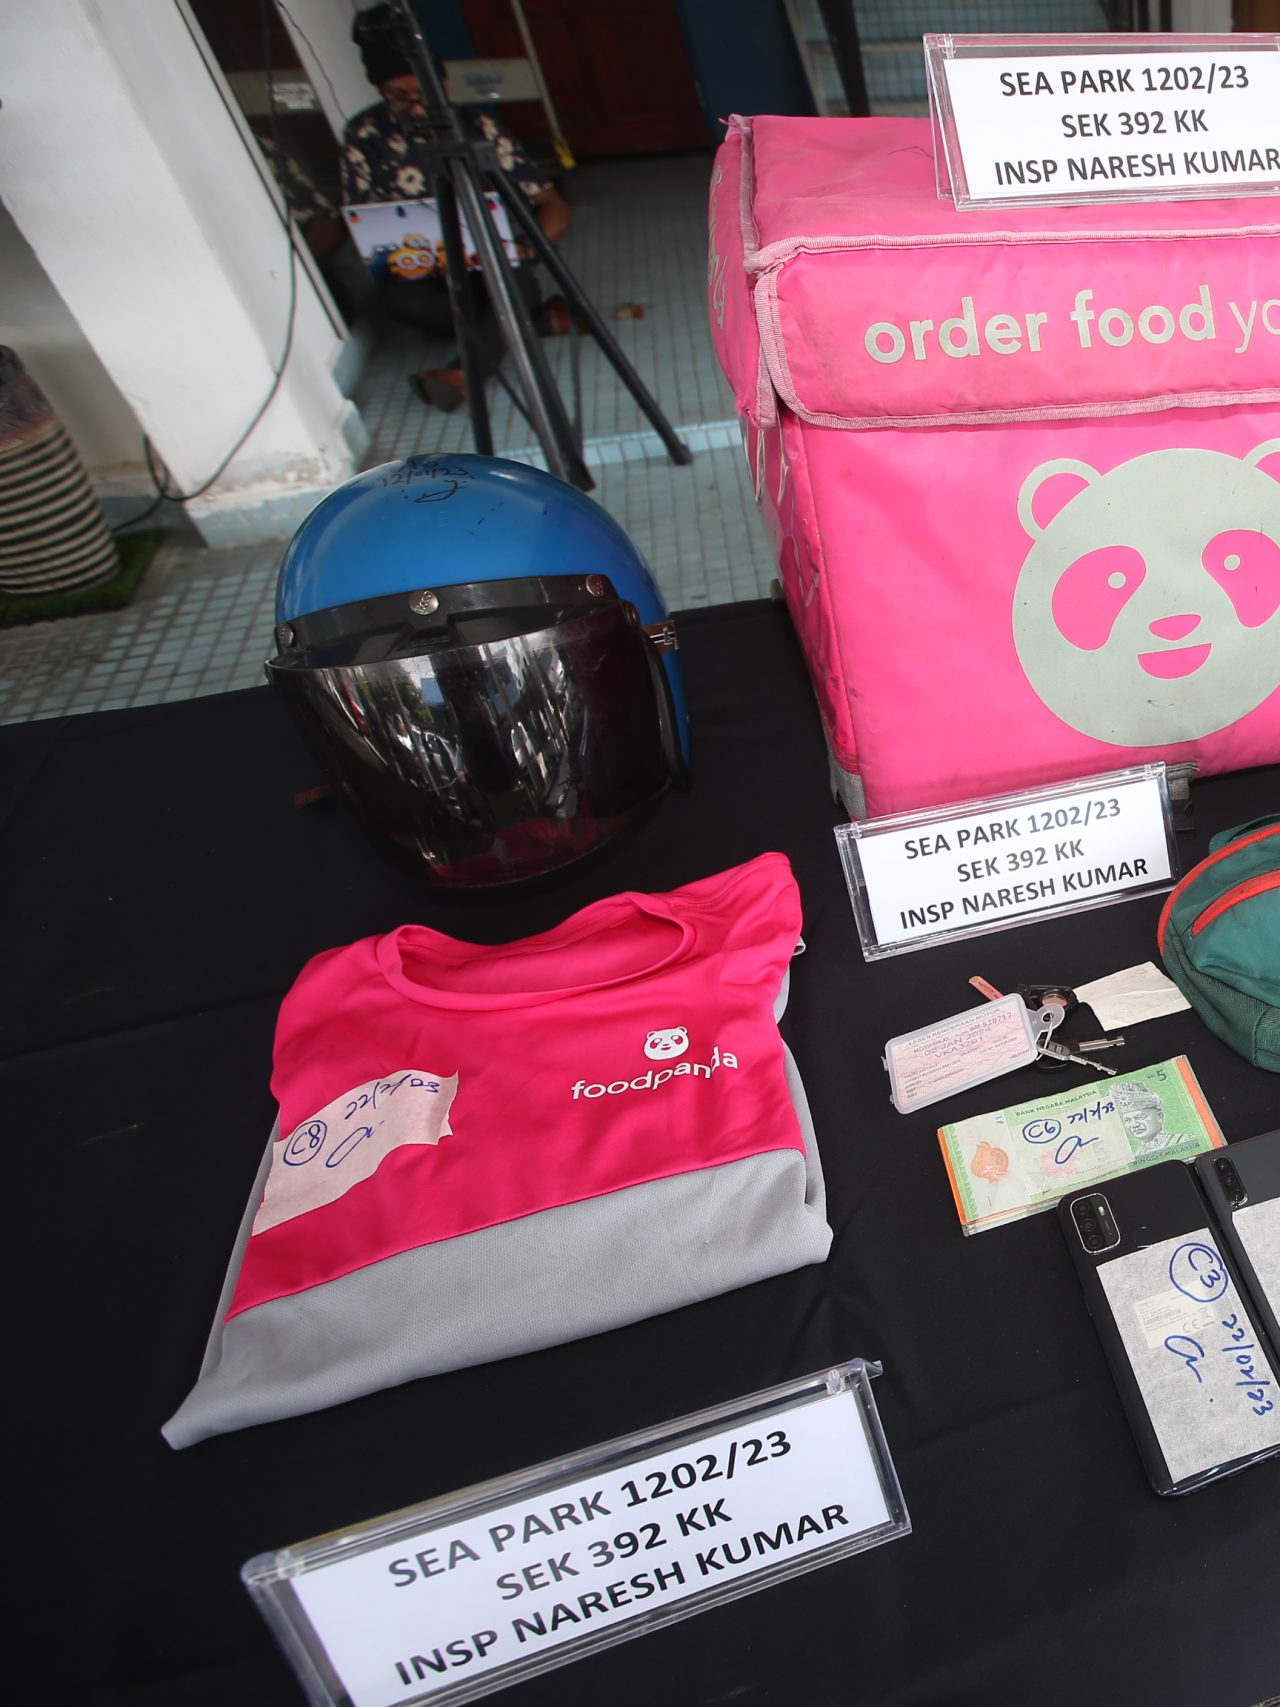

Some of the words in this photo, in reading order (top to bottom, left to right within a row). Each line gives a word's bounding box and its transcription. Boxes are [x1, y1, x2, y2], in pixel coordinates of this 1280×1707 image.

[999, 71, 1054, 97] SEA
[1062, 68, 1136, 95] PARK
[1141, 63, 1250, 94] 1202/23
[1061, 113, 1111, 139] SEK
[1118, 111, 1167, 136] 392
[1175, 109, 1209, 132] KK
[994, 159, 1058, 186] INSP
[1068, 153, 1176, 182] NARESH
[864, 296, 1049, 364] order
[1070, 285, 1217, 348] food
[904, 834, 952, 860] SEA
[957, 818, 1021, 848] PARK
[1027, 798, 1122, 834] 1202/23
[956, 857, 1001, 883] SEK
[1006, 846, 1049, 872] 392
[1054, 838, 1085, 863] KK
[900, 901, 955, 929] INSP
[962, 877, 1056, 916] NARESH
[1063, 857, 1149, 893] KUMAR
[941, 1037, 963, 1050] JAN
[570, 1046, 738, 1099] foodpanda
[1156, 1069, 1168, 1081] 5
[1016, 1107, 1034, 1117] BANK
[1036, 1100, 1064, 1112] NEGARA
[1064, 1090, 1097, 1105] MALAYSIA
[1028, 1122, 1056, 1139] C6
[1163, 1141, 1201, 1157] MALAYSIA
[1188, 1248, 1221, 1288] C3
[387, 1538, 482, 1588] SEA
[488, 1489, 613, 1553] PARK
[619, 1430, 793, 1509] 1202/23
[495, 1552, 581, 1602] SEK
[591, 1529, 668, 1570] 392
[677, 1497, 734, 1539] KK
[394, 1629, 499, 1686] INSP
[510, 1561, 687, 1643] NARESH
[695, 1504, 850, 1576] KUMAR
